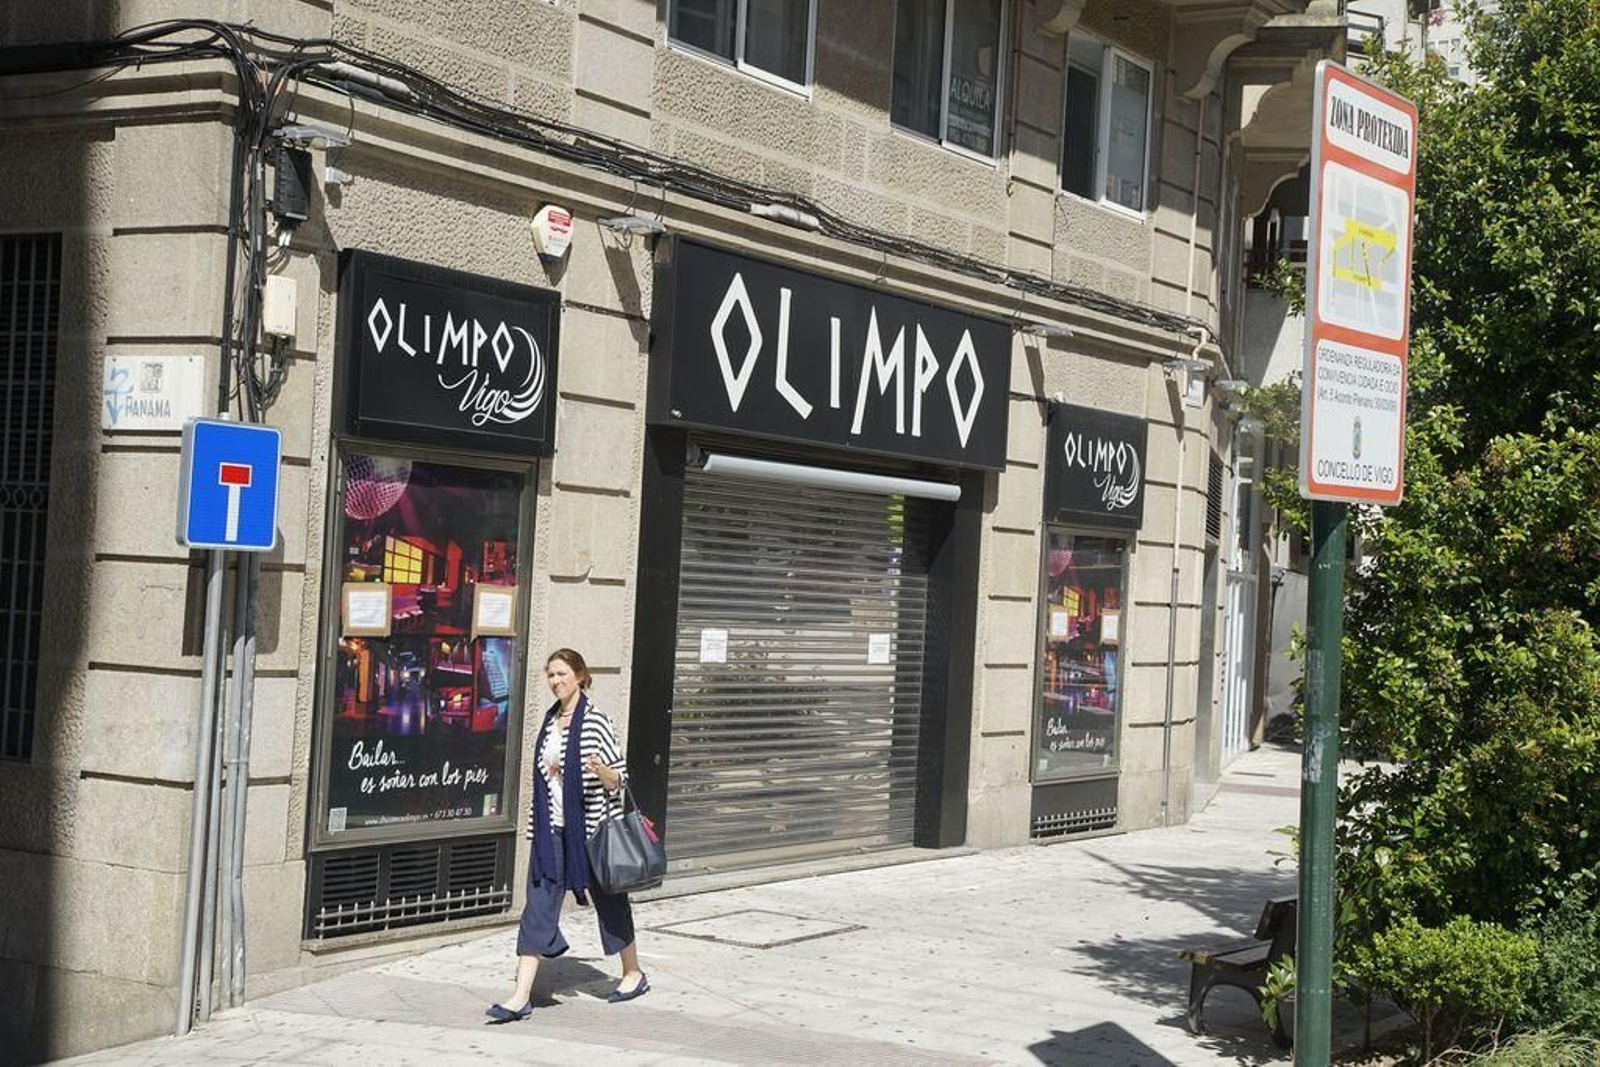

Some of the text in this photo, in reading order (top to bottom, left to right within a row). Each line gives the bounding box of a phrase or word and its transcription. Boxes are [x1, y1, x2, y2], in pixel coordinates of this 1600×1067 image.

[950, 77, 990, 111] ALQUILA
[1330, 95, 1408, 159] ZONA PROTEXIDA
[368, 297, 514, 373] OLIMPO
[711, 272, 984, 448] OLIMPO
[1319, 347, 1353, 367] ORDENANZA
[125, 396, 171, 419] PANAMA
[438, 369, 516, 426] Vigo
[1065, 431, 1126, 475] OLIMPO
[1318, 460, 1393, 484] CONCELLO DE VIGO
[1093, 473, 1124, 511] Vigo
[361, 761, 490, 794] es soñar con los pies
